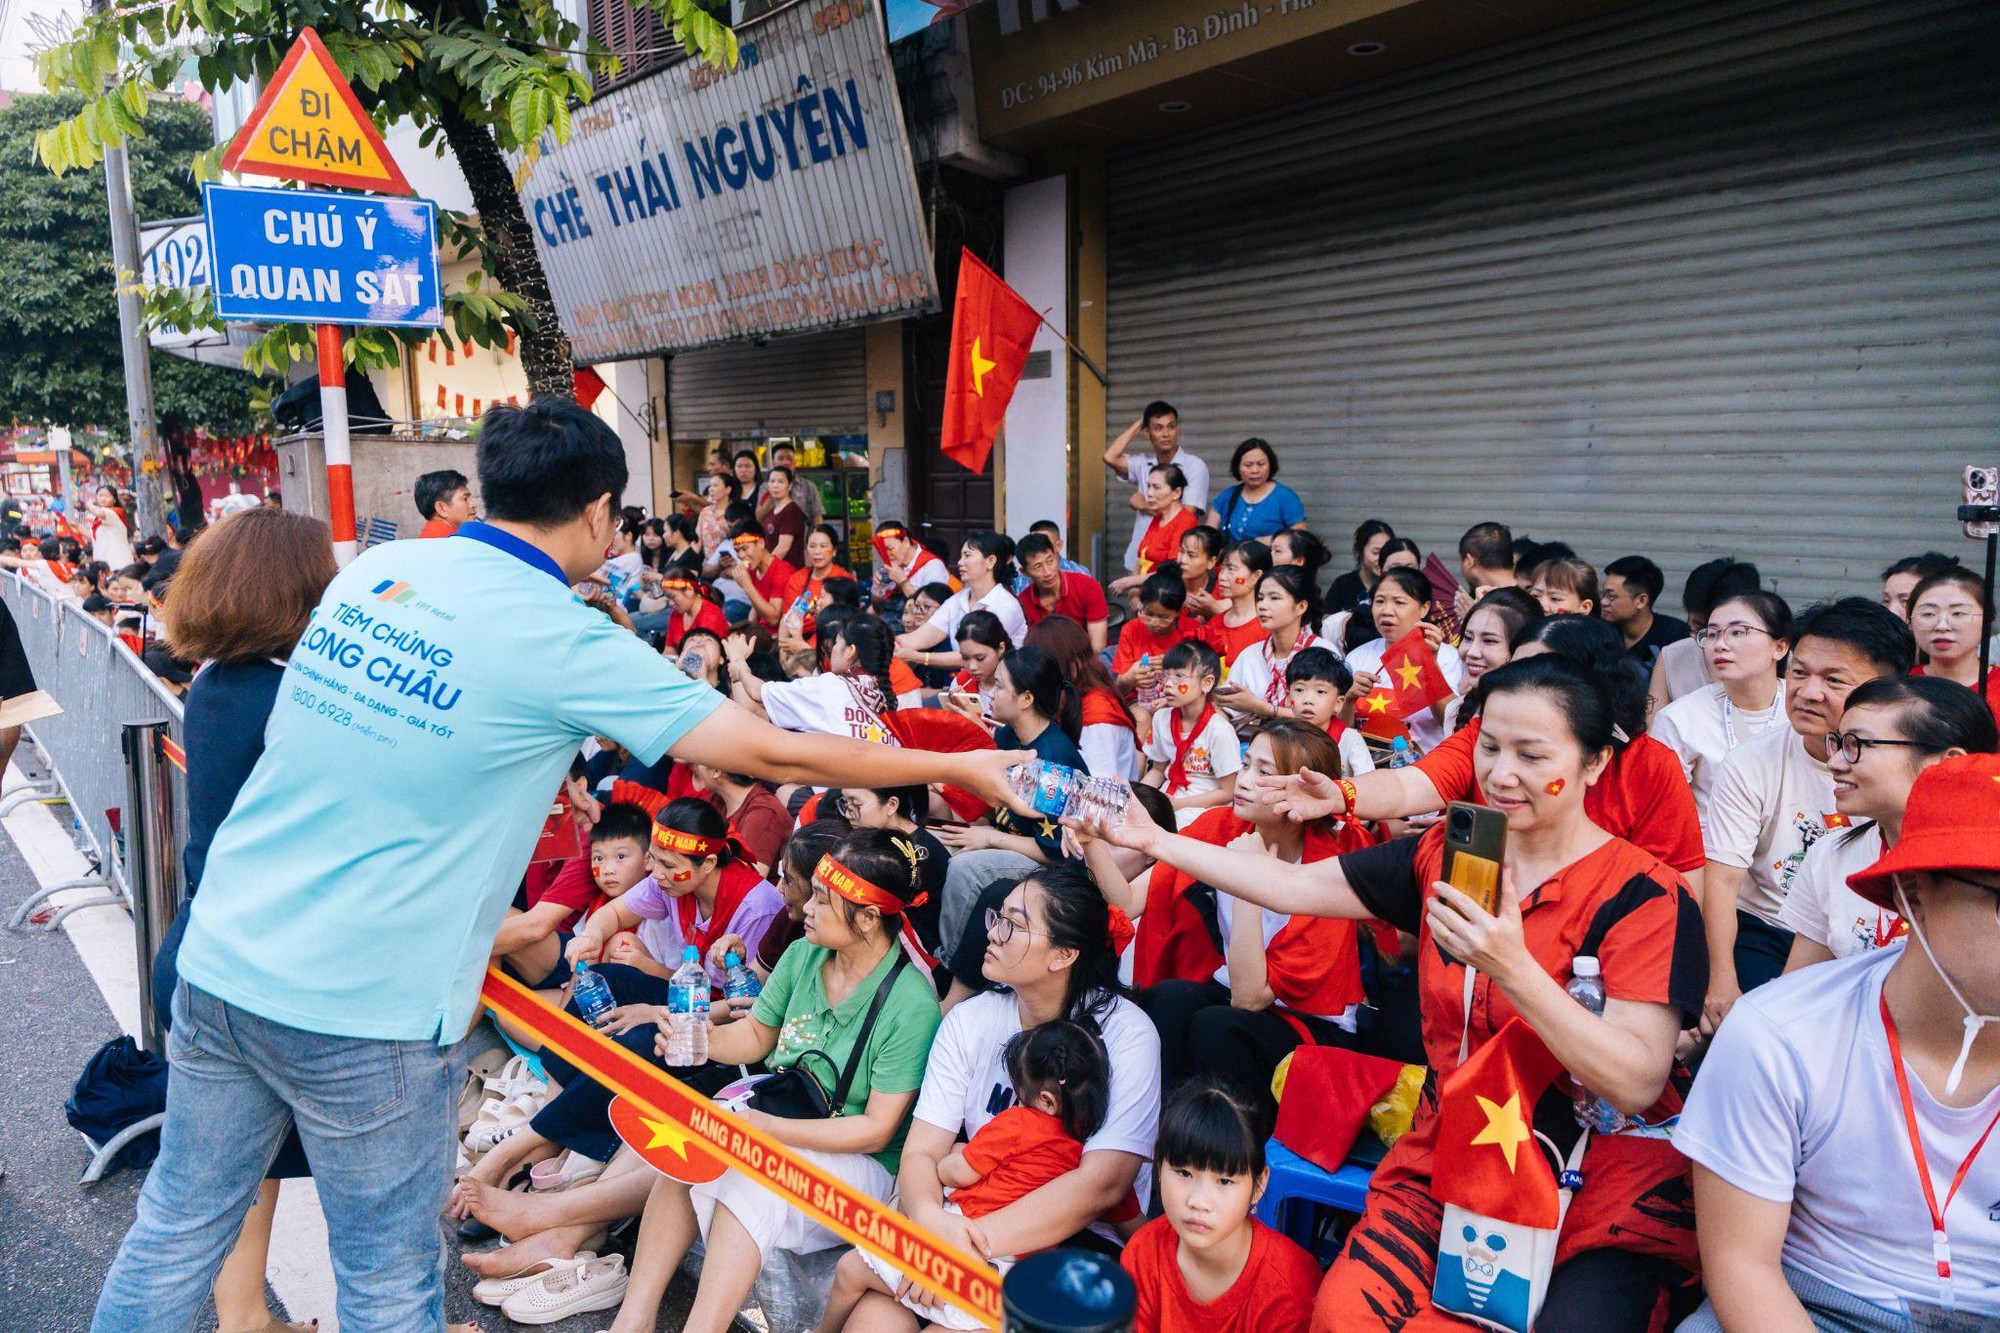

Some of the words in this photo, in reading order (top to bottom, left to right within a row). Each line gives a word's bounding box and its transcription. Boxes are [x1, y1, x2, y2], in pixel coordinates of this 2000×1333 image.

[1038, 63, 1083, 96] 94-96
[1086, 52, 1123, 80] Kim
[1127, 37, 1159, 66] Mã
[1173, 25, 1199, 51] Ba
[1202, 1, 1259, 41] Đình
[300, 88, 331, 119] ĐI
[269, 127, 362, 167] CHẬM
[533, 171, 593, 248] CHÈ
[596, 137, 681, 228] THÁI
[683, 74, 869, 200] NGUYÊN
[264, 205, 343, 248] CHÚ
[355, 208, 378, 250] Ý
[230, 263, 342, 303] QUAN
[355, 264, 424, 306] SÁT
[414, 601, 430, 613] FPT
[430, 607, 457, 622] Retail
[332, 603, 374, 632] TIÊM
[372, 623, 453, 667] CHỦNG
[291, 685, 316, 709] 1800
[317, 700, 353, 726] 6928
[366, 656, 462, 711] CHÂU
[353, 691, 366, 705] ĐA
[367, 699, 398, 718] DẠNG
[407, 714, 427, 730] GIÁ
[430, 724, 455, 739] TỐT
[675, 836, 698, 851] NAM
[828, 870, 855, 894] NAM
[690, 1107, 729, 1148] HÀNG
[731, 1132, 763, 1169] RÀO
[854, 1208, 897, 1254] CẤM
[901, 1235, 966, 1293] VƯỢT
[969, 1279, 1001, 1317] QU
